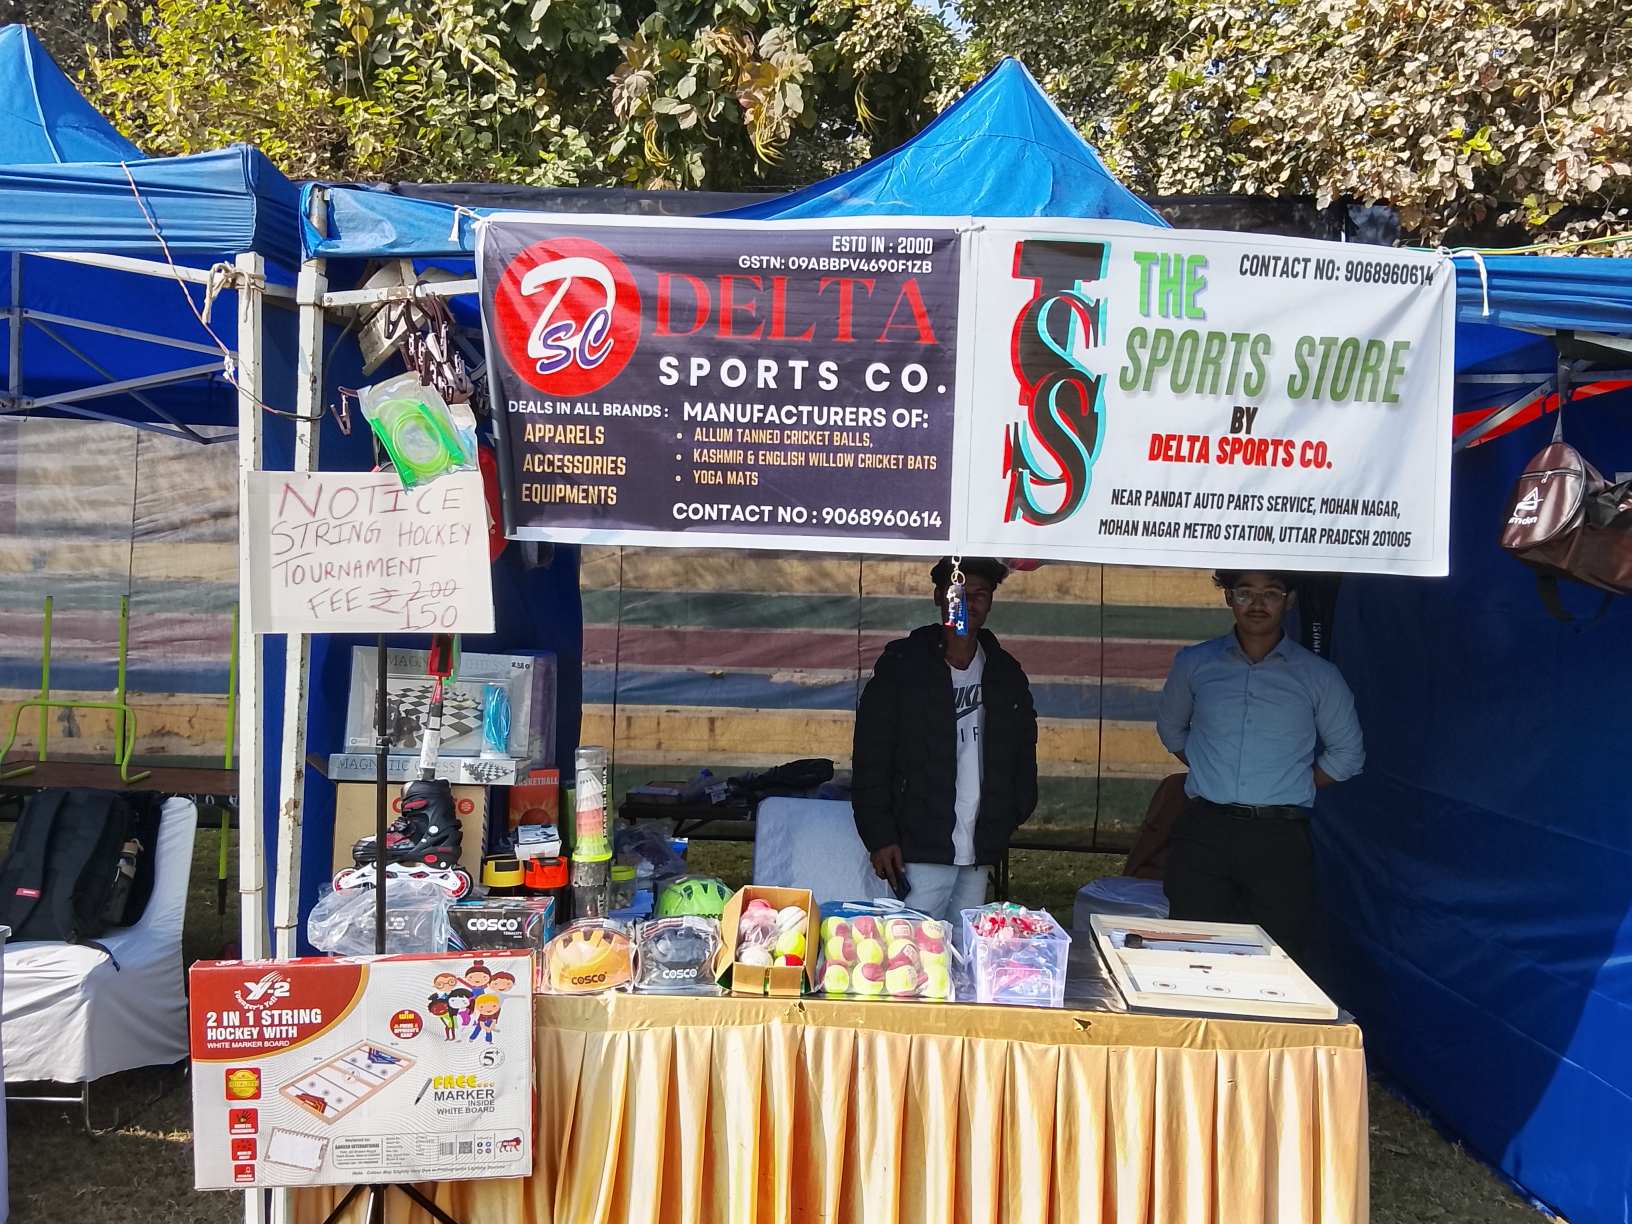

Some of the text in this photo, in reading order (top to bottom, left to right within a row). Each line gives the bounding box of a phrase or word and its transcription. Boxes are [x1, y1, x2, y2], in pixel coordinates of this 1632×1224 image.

[832, 235, 867, 253] ESTD
[871, 236, 885, 254] IN
[897, 237, 933, 254] 2000
[738, 255, 785, 270] GSTN:
[1239, 253, 1435, 287] CONTACT NO: 9068960614
[1133, 251, 1209, 321] THE
[652, 271, 941, 345] DELTA
[659, 355, 947, 394] SPORTS CO.
[1118, 326, 1412, 404] SPORTS STORE
[508, 399, 554, 415] DEALS
[556, 401, 571, 415] IN
[573, 402, 601, 416] ALL
[602, 403, 662, 418] BRANDS
[683, 402, 930, 429] MANUFACTURERS OF:
[1229, 406, 1259, 435] BY
[524, 423, 606, 446] APPARELS
[694, 427, 873, 449] ALLUM TANNED CRICKET BALLS,
[693, 448, 938, 471] KASHMIR & ENGLISH WILLOW CRICKET BATS
[1148, 433, 1334, 470] DELTA SPORTS CO.
[523, 453, 627, 476] ACCESSORIES
[693, 469, 760, 487] YOGA MATS
[277, 482, 466, 521] NOTICE
[522, 483, 618, 506] EQUIPMENTS
[1111, 488, 1402, 520] NEAR PANDAT AUTO PARTS SERVICE, MOHAN NAGAR,
[672, 502, 773, 523] CONTACT
[777, 506, 808, 524] NO
[821, 507, 943, 528] 9068960614
[271, 517, 473, 556] STRING HOCKEY
[1098, 518, 1413, 548] MOHAN NAGAR METRO STATION, UTTAR PRADESH 201005
[271, 551, 441, 588] TOURNAMENT
[307, 585, 364, 620] FEE
[399, 600, 459, 632] 150
[335, 757, 411, 772] MAGNTIC
[467, 918, 519, 931] COSCO
[571, 972, 607, 985] COSCO
[662, 967, 699, 979] COSCO
[206, 1008, 323, 1026] 2 IN 1 STRING
[206, 1025, 298, 1040] HOCKEY WITH
[231, 1040, 263, 1048] MARKER
[264, 1039, 291, 1048] BOARD
[434, 1088, 496, 1101] MARKER
[467, 1099, 496, 1107] INSIDE
[436, 1106, 496, 1115] WHITE BOARD
